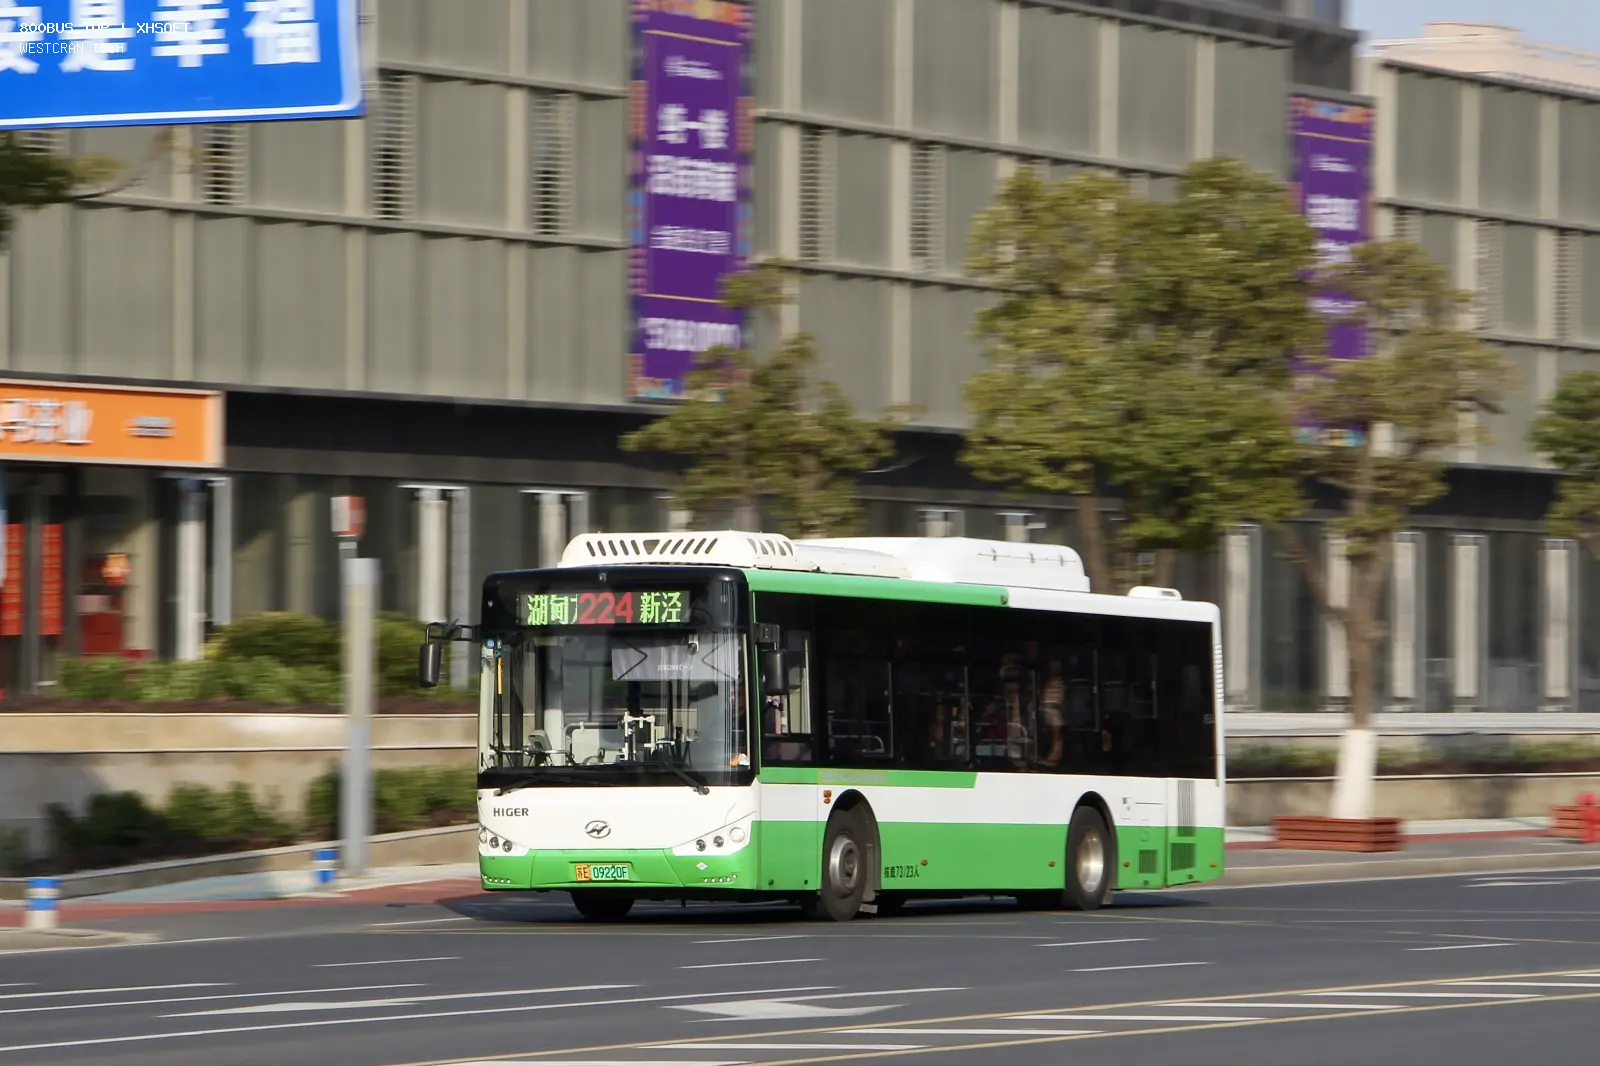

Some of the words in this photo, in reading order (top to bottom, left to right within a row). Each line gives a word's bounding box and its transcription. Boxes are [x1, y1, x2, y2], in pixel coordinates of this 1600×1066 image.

[578, 592, 633, 624] 224
[639, 592, 682, 623] 新泾
[493, 807, 529, 817] HIGER
